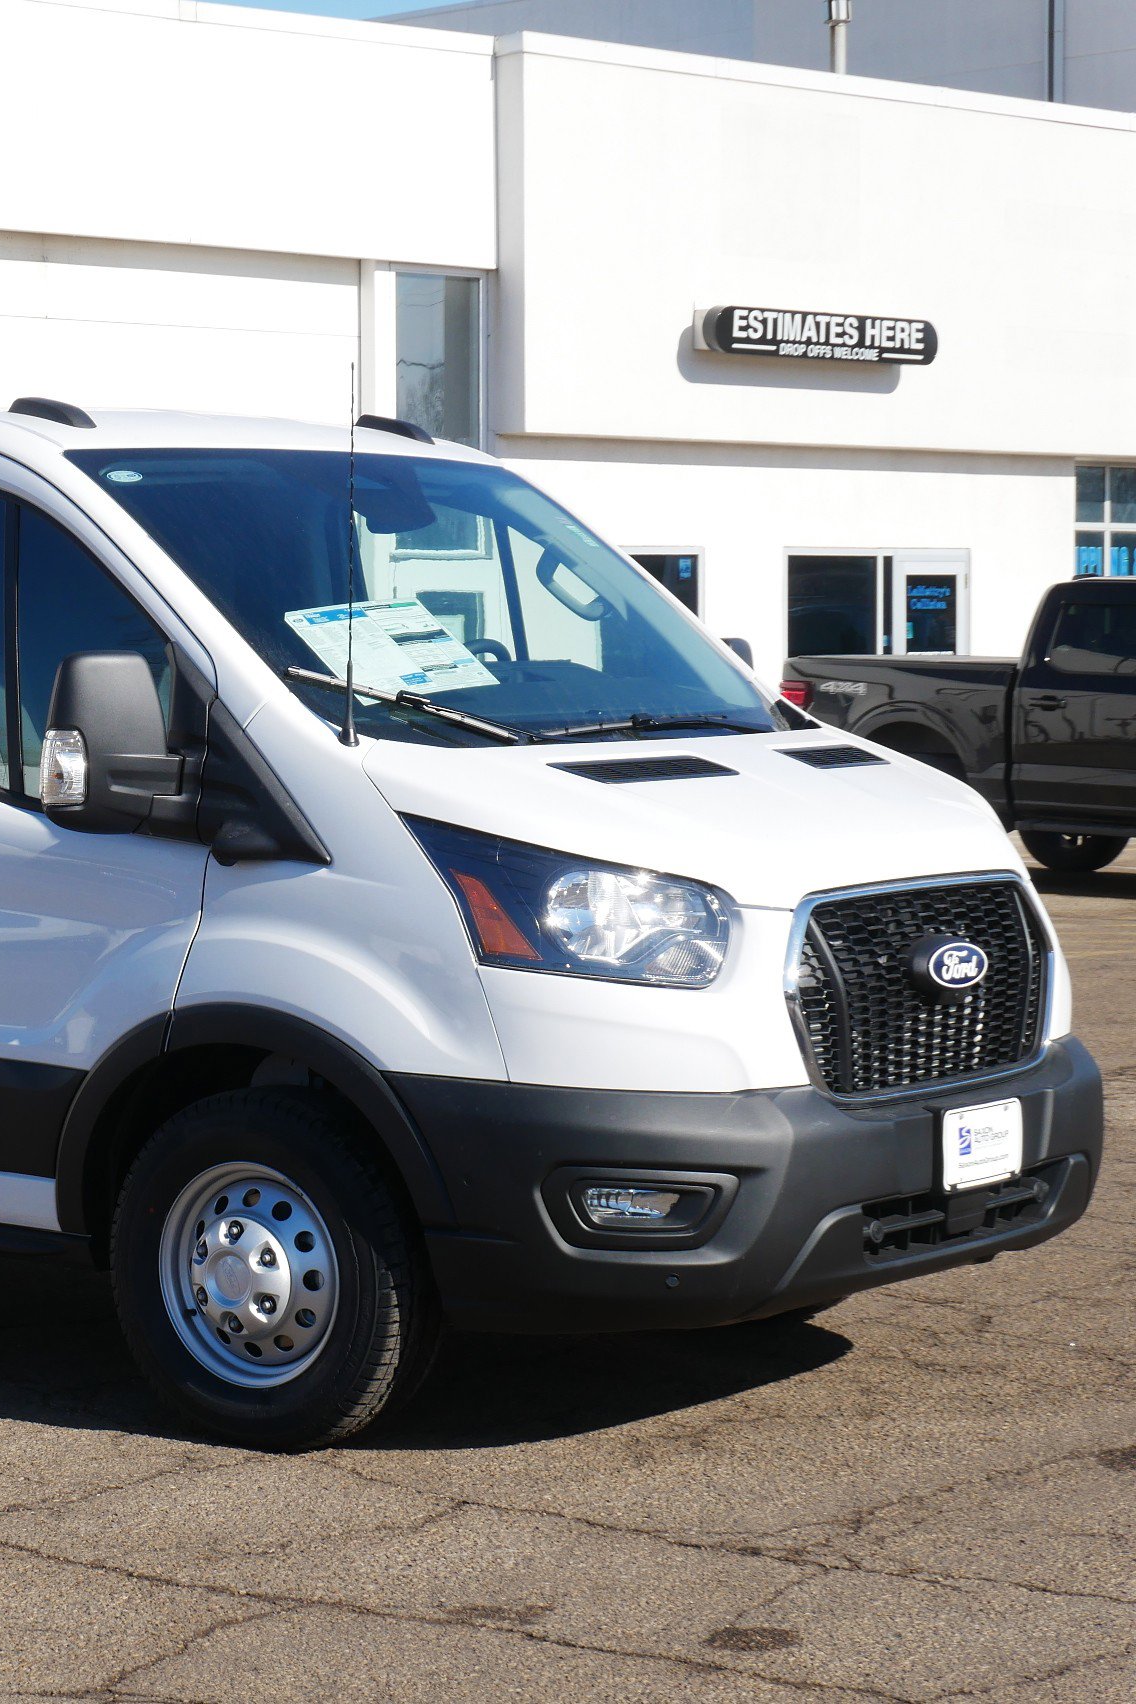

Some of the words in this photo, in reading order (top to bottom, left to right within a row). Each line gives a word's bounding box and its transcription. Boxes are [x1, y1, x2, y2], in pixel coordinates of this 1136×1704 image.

[732, 309, 860, 346] ESTIMATES
[865, 319, 925, 350] HERE
[778, 343, 807, 357] DROP
[808, 345, 833, 358] OFFS
[834, 348, 881, 361] WELCOME
[941, 950, 978, 980] Ford
